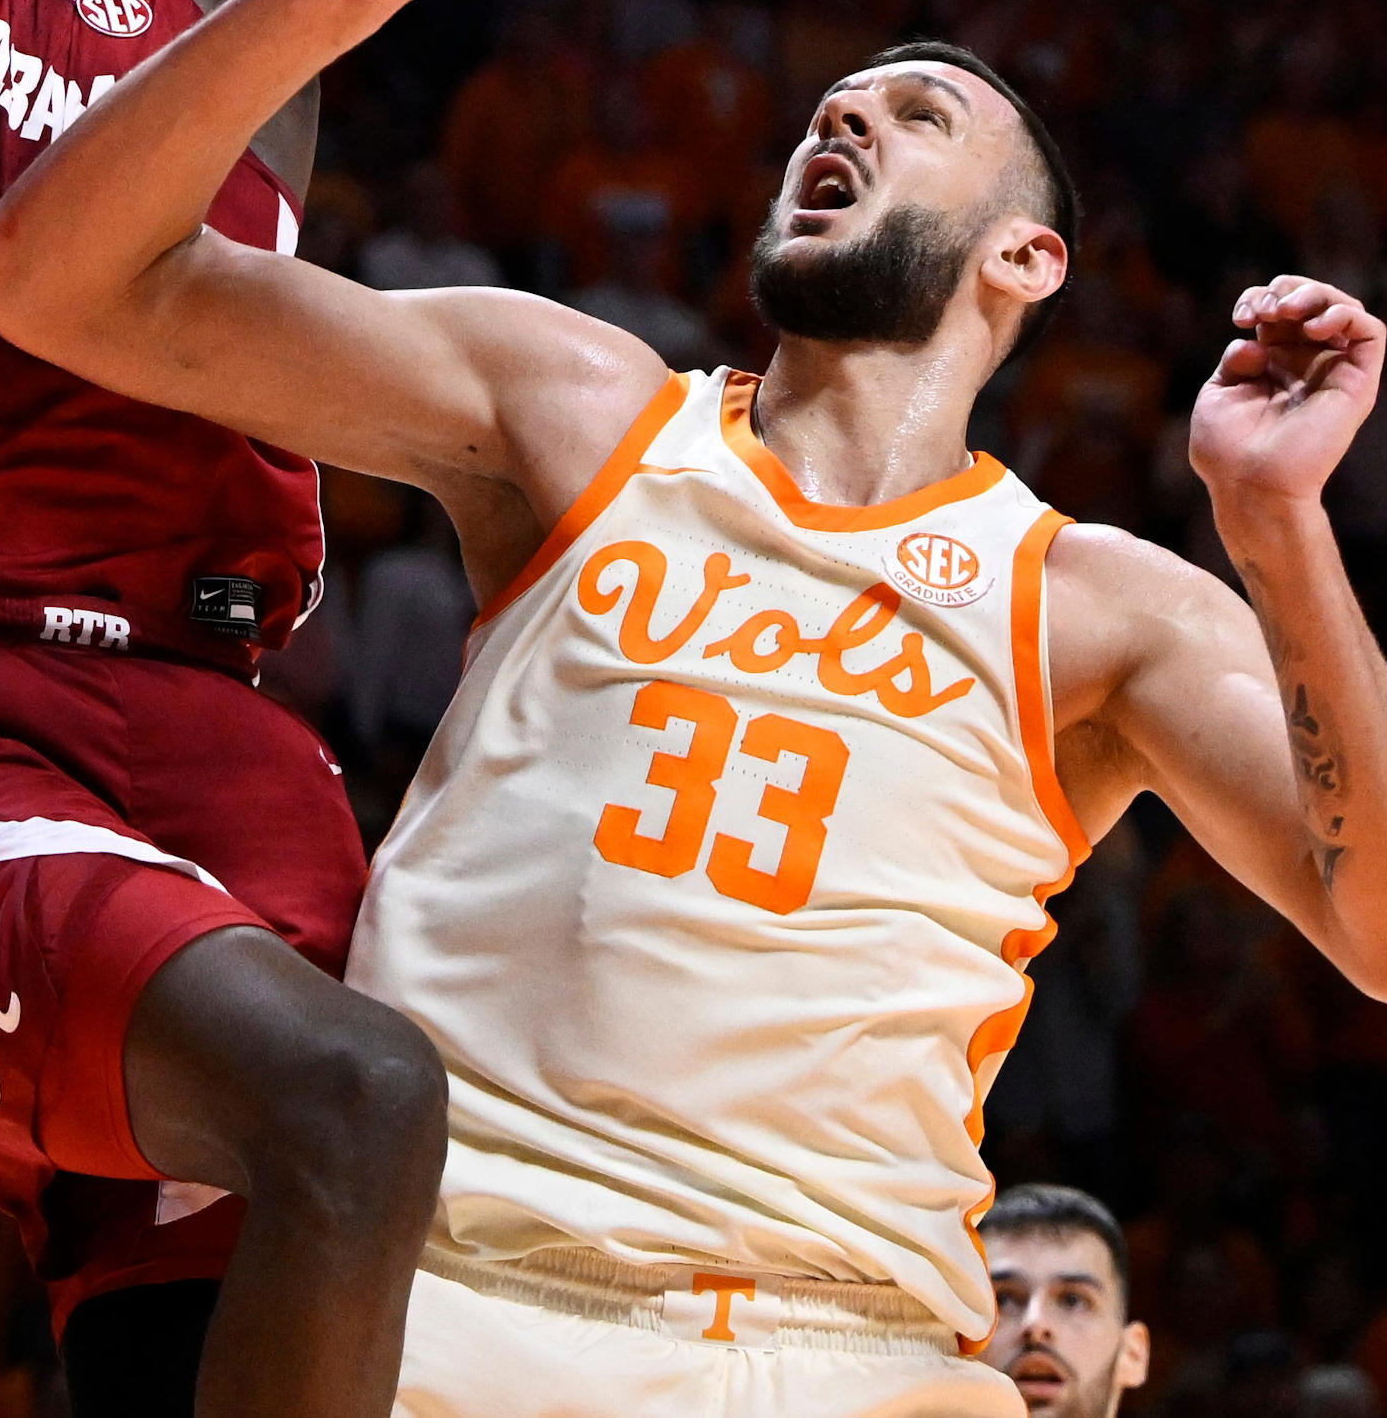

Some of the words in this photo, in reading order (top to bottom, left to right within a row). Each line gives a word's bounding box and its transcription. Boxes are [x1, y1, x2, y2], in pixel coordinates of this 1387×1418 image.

[894, 570, 978, 604] GRADUATE
[905, 536, 972, 587] SEC
[39, 606, 132, 652] RTR
[577, 539, 977, 719] Vols
[592, 678, 851, 916] 33
[691, 1271, 757, 1343] T
